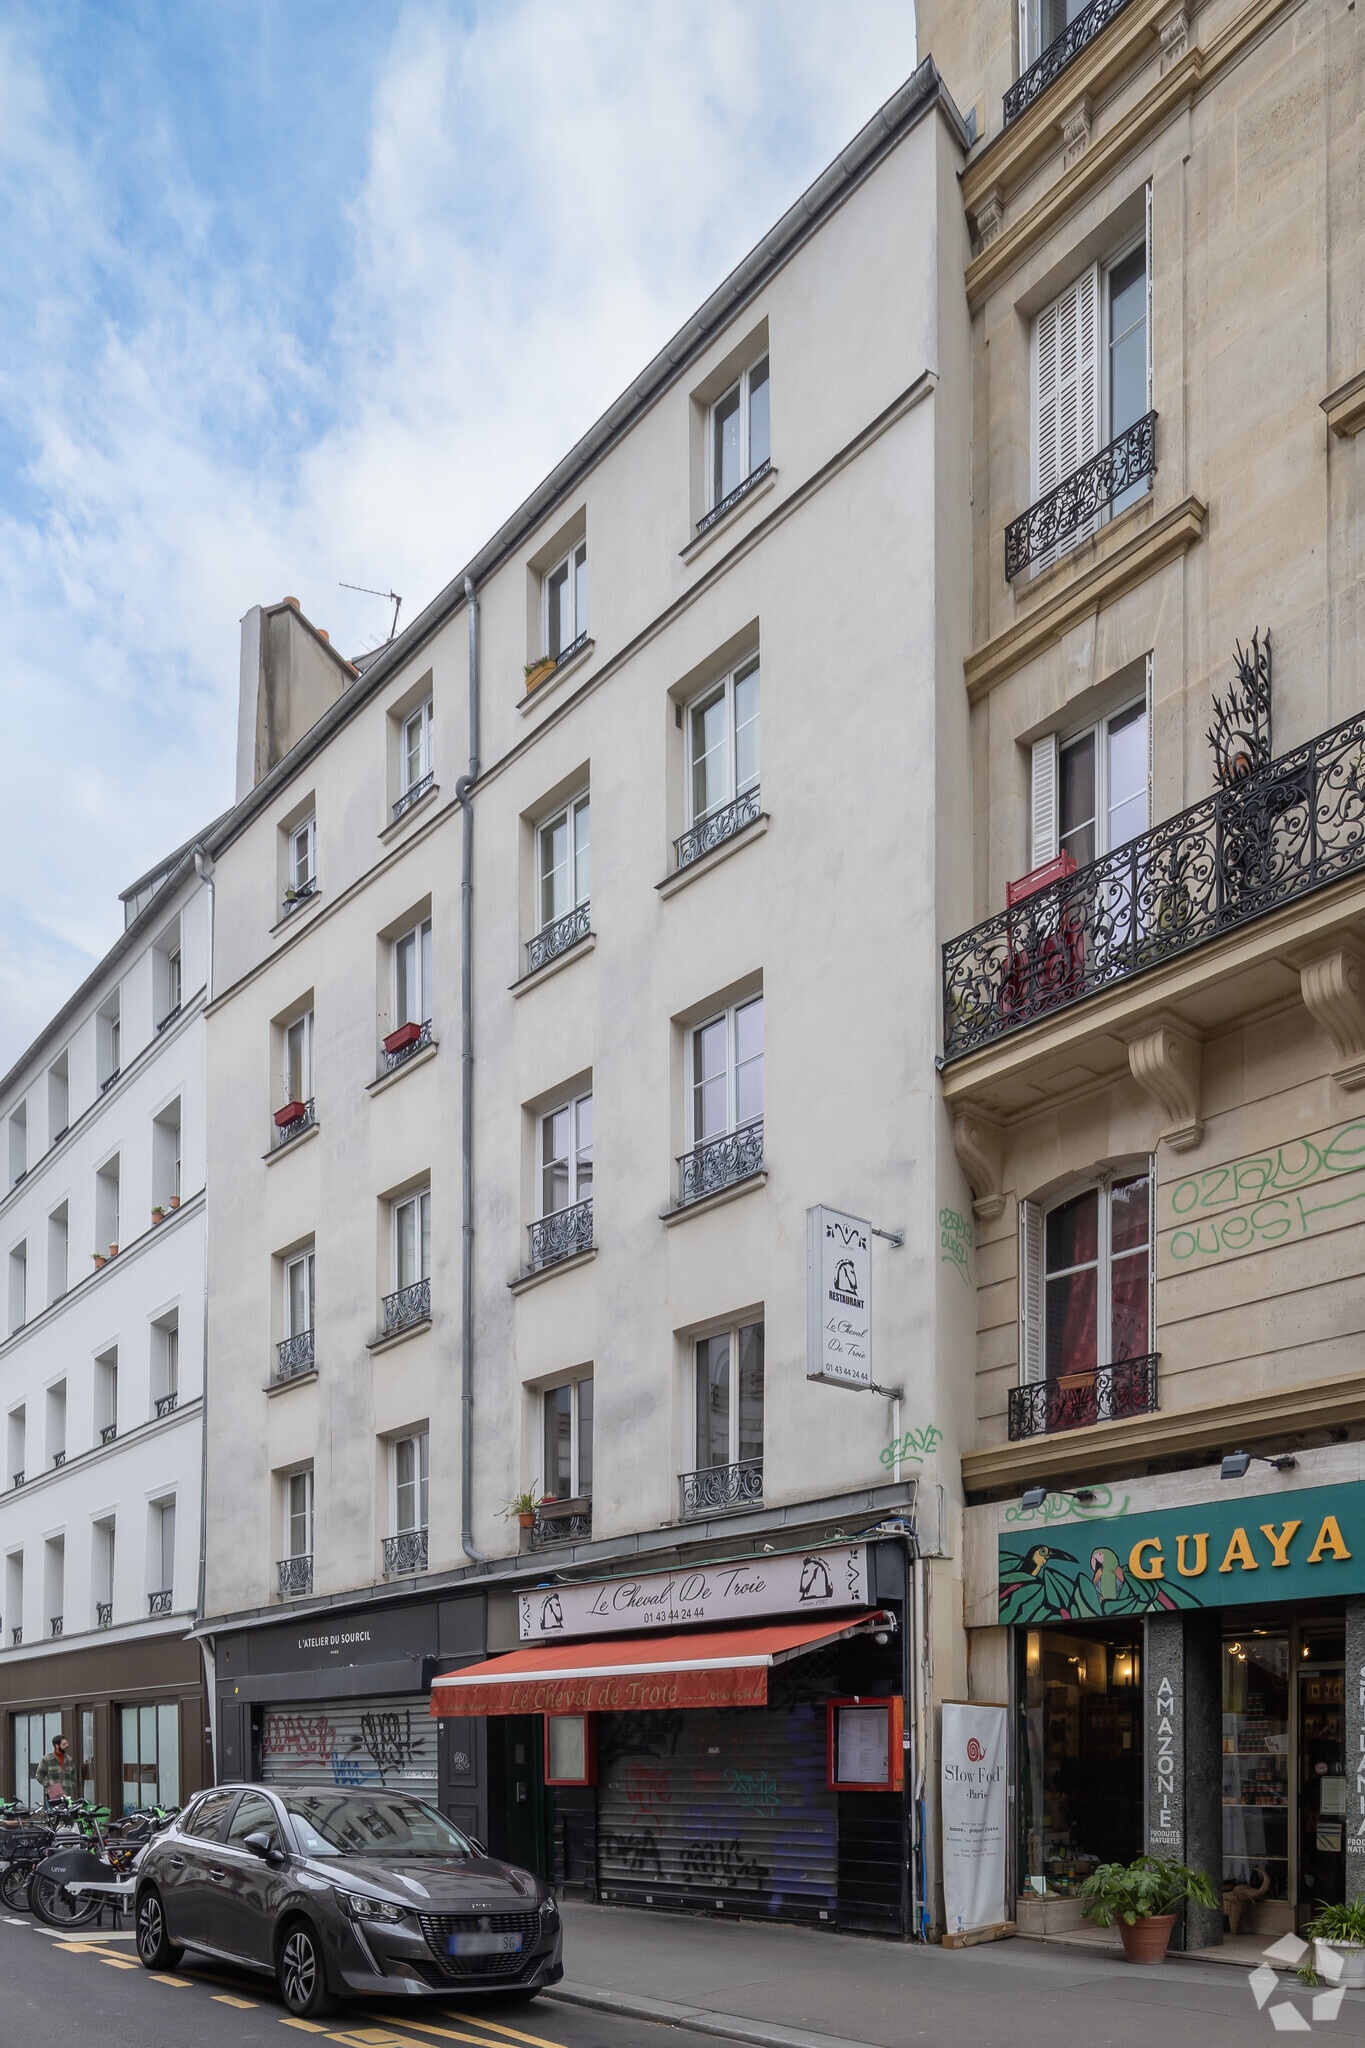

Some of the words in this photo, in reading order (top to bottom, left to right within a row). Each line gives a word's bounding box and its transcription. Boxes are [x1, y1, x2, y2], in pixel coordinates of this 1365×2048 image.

[828, 1290, 864, 1309] RESTAURANT
[824, 1317, 836, 1333] Le
[837, 1320, 868, 1338] Cheval
[828, 1338, 843, 1353] De
[845, 1343, 866, 1359] Troie
[825, 1363, 833, 1372] 01
[835, 1365, 842, 1374] 43
[843, 1367, 851, 1376] 44
[852, 1369, 860, 1379] 24
[860, 1371, 868, 1381] 44
[1128, 1515, 1352, 1581] GUAYA
[585, 1586, 609, 1615] Le
[612, 1581, 675, 1611] Cheval
[679, 1573, 712, 1602] De
[716, 1567, 767, 1597] Troie
[643, 1612, 653, 1623] 01
[655, 1610, 666, 1622] 43
[668, 1609, 679, 1621] 44
[681, 1608, 692, 1620] 24
[693, 1607, 705, 1618] 44
[298, 1636, 329, 1649] L'ATELIER
[330, 1634, 340, 1645] DU
[341, 1630, 371, 1644] SOURCIL
[508, 1687, 528, 1710] Le
[534, 1681, 597, 1709] Cheval
[598, 1679, 619, 1705] de
[626, 1680, 678, 1704] Troie
[1156, 1676, 1174, 1828] AMAZONIE
[945, 1764, 975, 1783] Slow
[969, 1788, 987, 1800] Paris
[1150, 1830, 1181, 1838] PRODUITS
[1150, 1836, 1181, 1845] NATURELS
